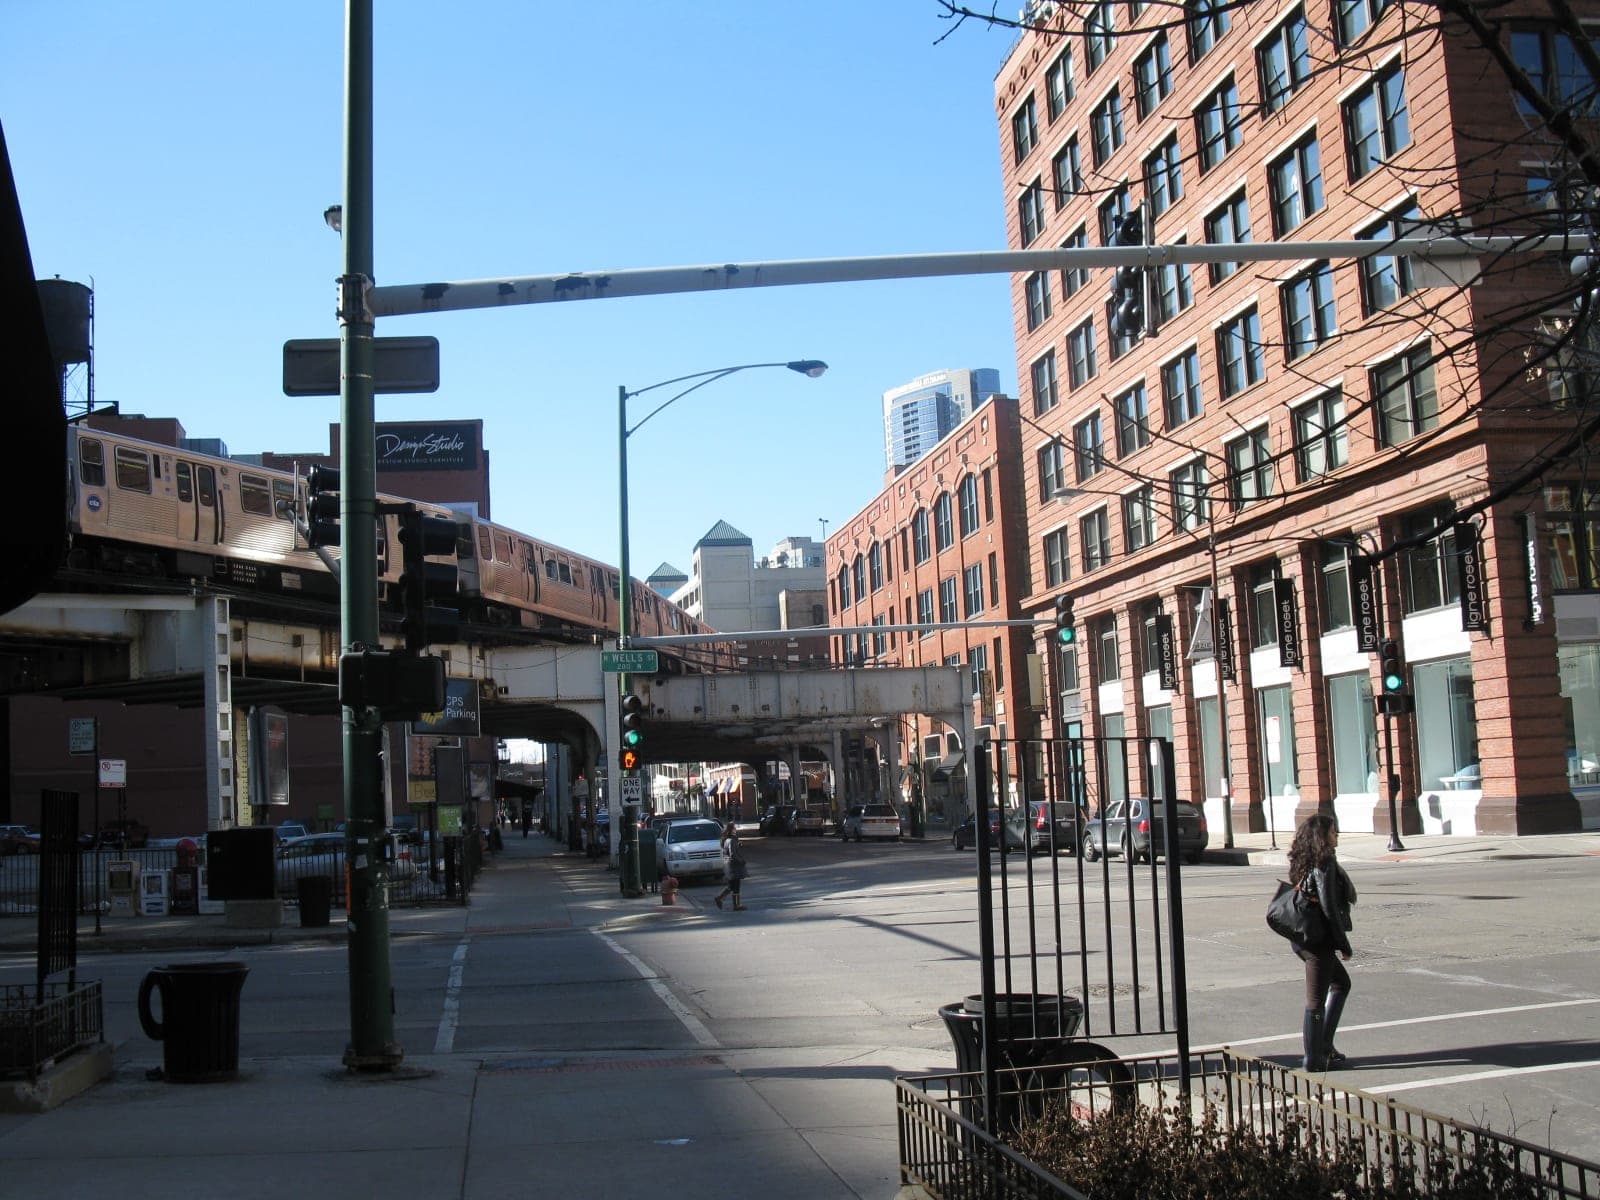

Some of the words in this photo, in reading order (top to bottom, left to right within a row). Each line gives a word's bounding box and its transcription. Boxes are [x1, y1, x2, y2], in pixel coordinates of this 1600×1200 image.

[1527, 540, 1538, 582] roset
[1359, 578, 1370, 614] roset
[1467, 592, 1482, 628] ligne
[1530, 584, 1542, 622] ligne
[1281, 599, 1292, 633] roset
[1161, 632, 1171, 661] roset
[1363, 614, 1376, 649] ligne
[612, 653, 644, 663] WELLS
[1284, 634, 1297, 664] ligne
[1163, 662, 1174, 688] ligne
[446, 707, 476, 721] Parking
[623, 779, 641, 787] ONE
[623, 787, 641, 795] WAY
